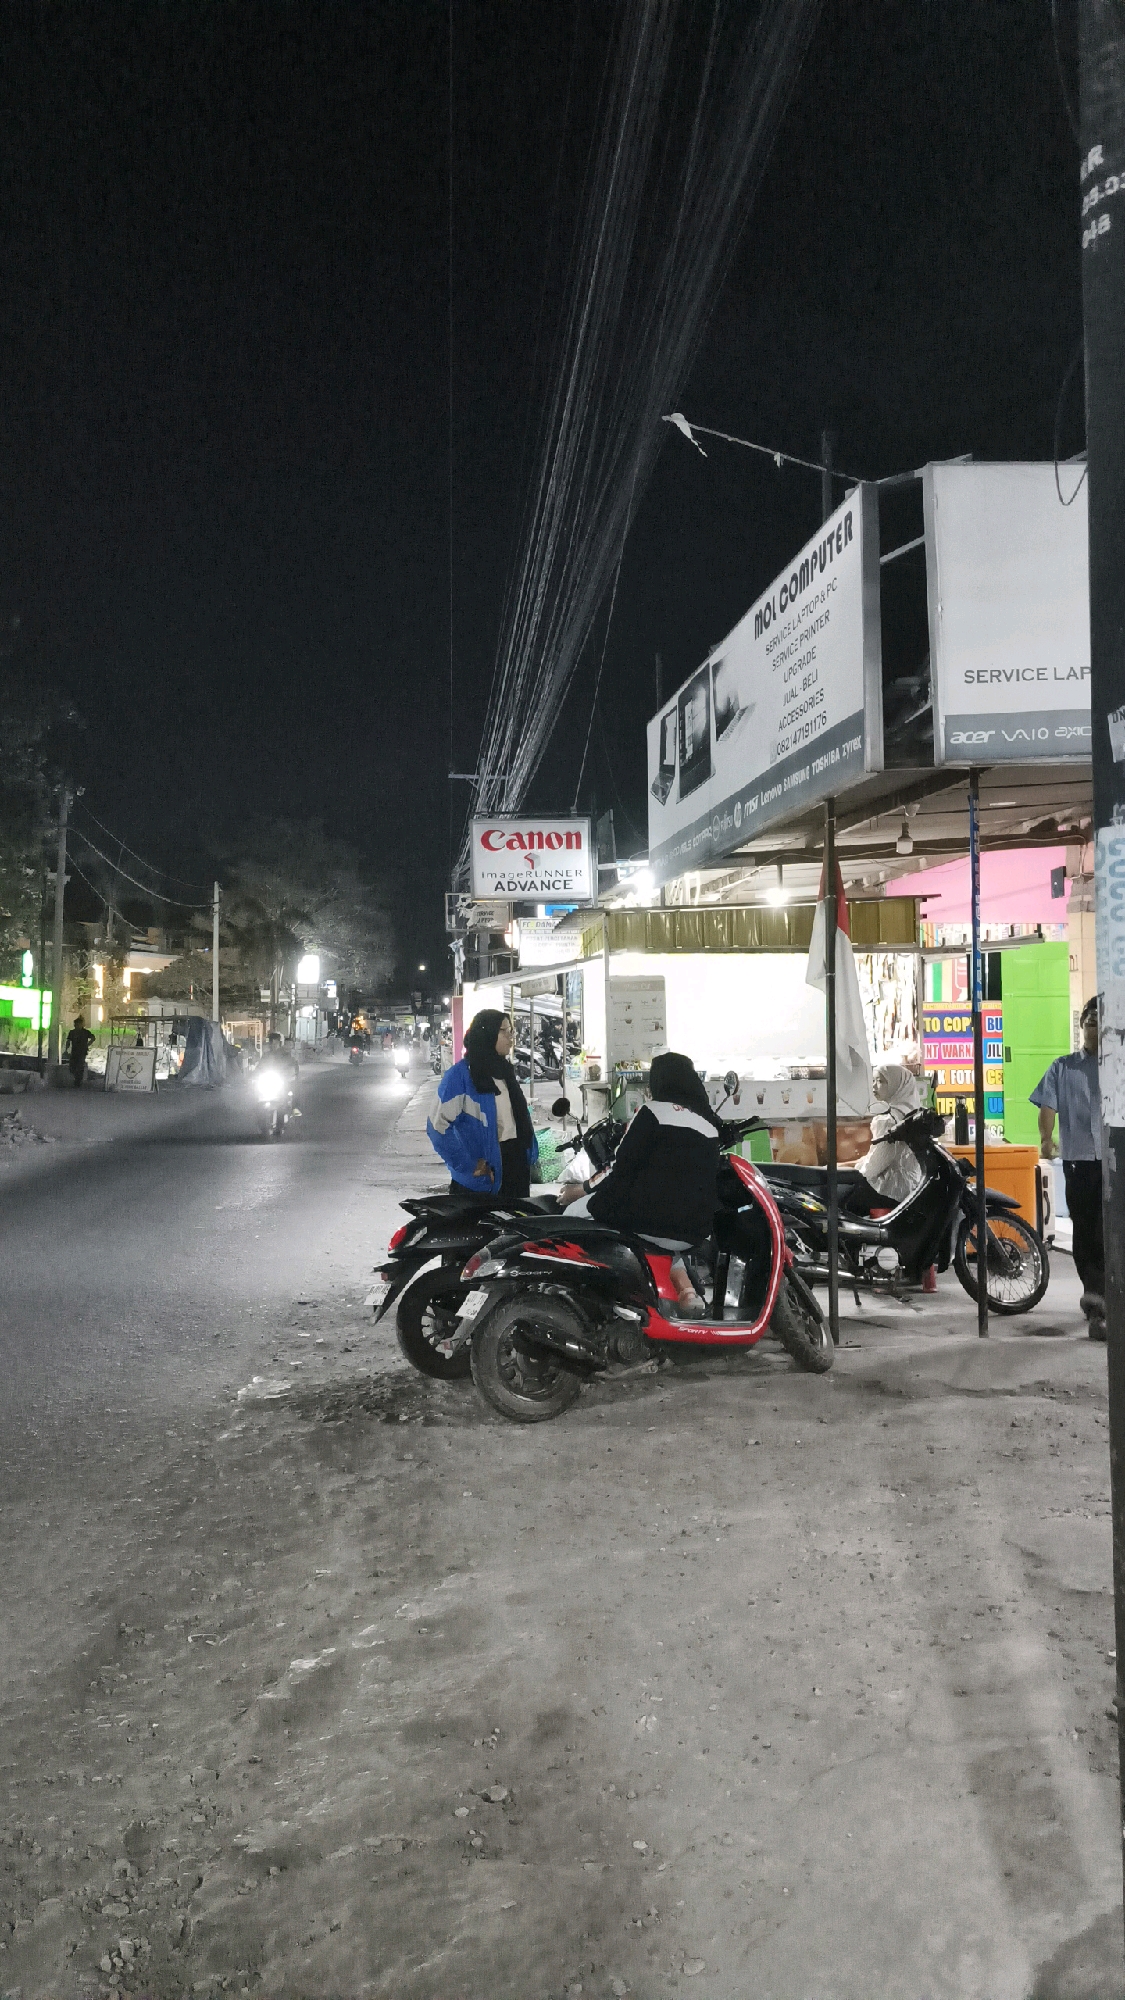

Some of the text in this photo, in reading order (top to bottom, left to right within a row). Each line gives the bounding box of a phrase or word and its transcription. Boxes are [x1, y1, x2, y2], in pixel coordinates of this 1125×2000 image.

[779, 510, 853, 613] COMPUTER
[766, 622, 792, 656] SERVICE
[793, 595, 820, 631] LAPTOP
[827, 577, 838, 598] PC
[772, 609, 830, 672] SERVICE PRINTER
[783, 646, 817, 683] UPGRADE
[964, 666, 1091, 684] SERVICE LAP
[803, 668, 818, 692] BELI
[778, 688, 825, 732] ACCESSORIES
[950, 730, 996, 744] acer
[1001, 727, 1049, 742] VAIO
[812, 748, 840, 776] TOSHIBA
[481, 829, 582, 852] Canon
[494, 879, 574, 892] ADVANCE
